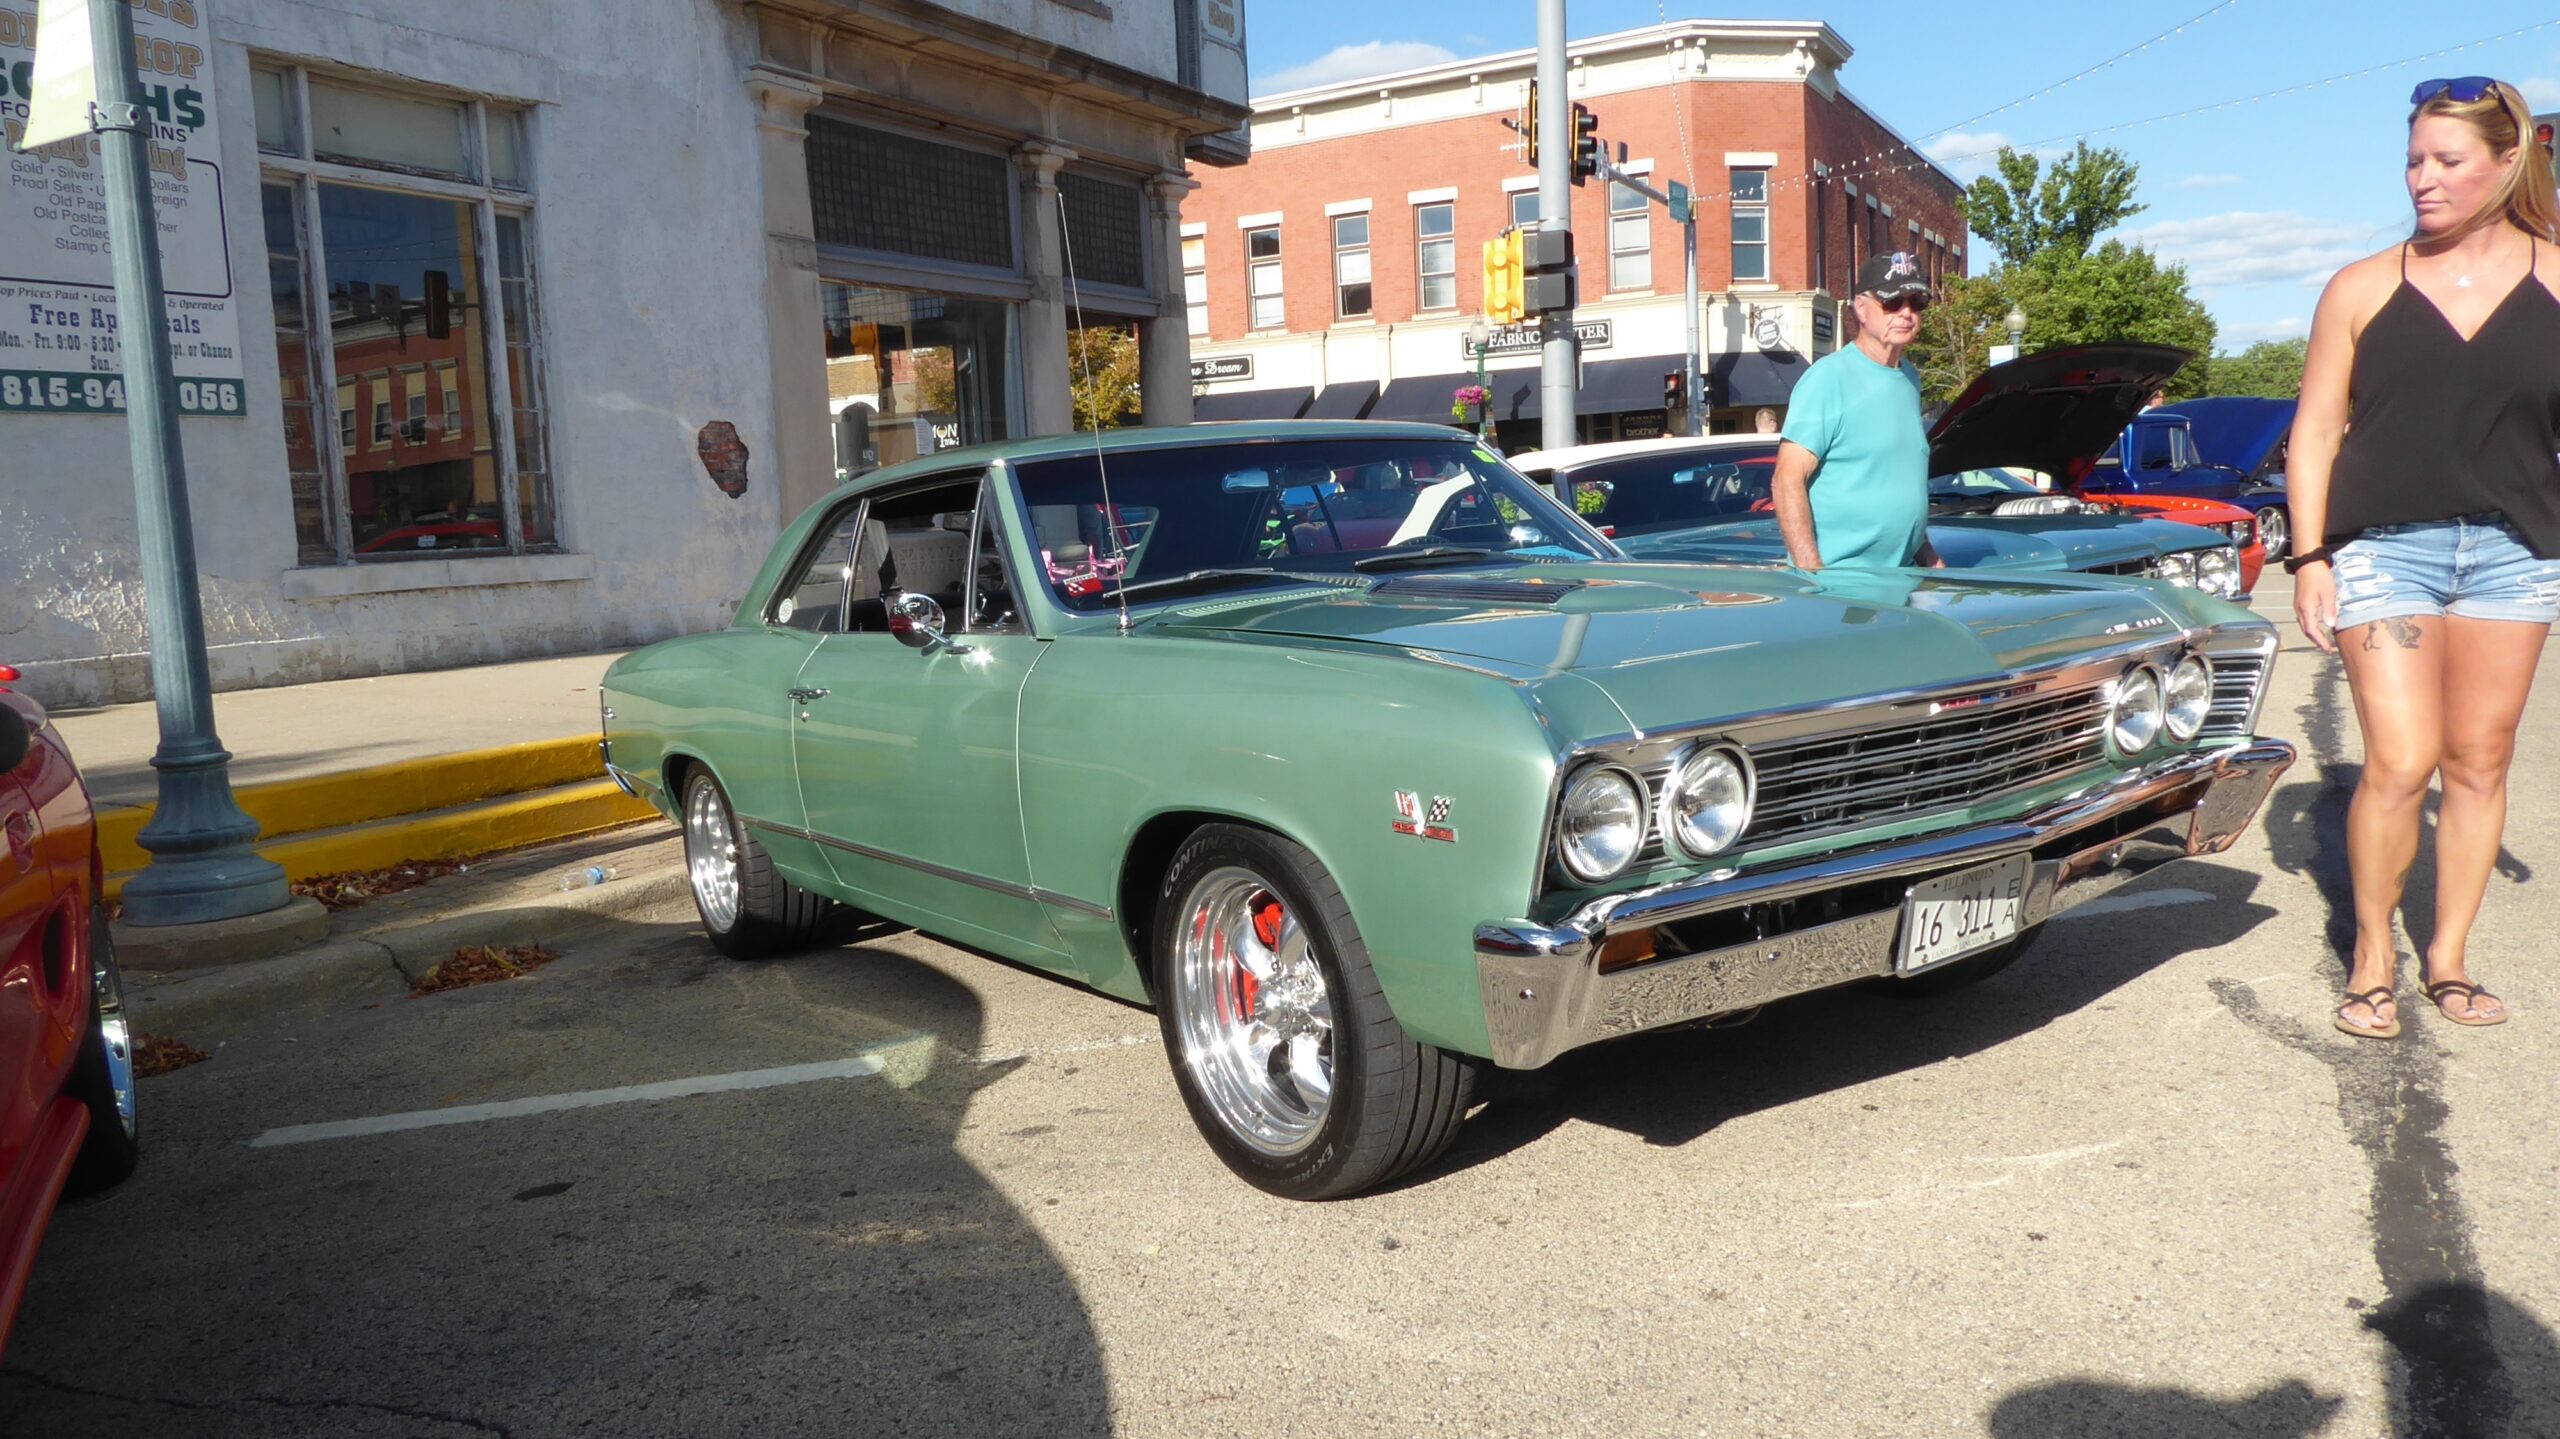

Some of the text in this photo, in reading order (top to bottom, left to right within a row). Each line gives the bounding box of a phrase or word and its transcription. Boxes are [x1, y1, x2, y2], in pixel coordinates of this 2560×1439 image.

[11, 160, 44, 175] Gold
[57, 166, 94, 181] Silver
[12, 174, 48, 190] Proof
[53, 180, 83, 194] Sets
[152, 195, 188, 208] oreign
[49, 194, 73, 207] Old
[34, 206, 58, 220] Old
[62, 209, 106, 225] Postca
[55, 237, 98, 255] Stamp
[0, 287, 15, 297] op
[18, 287, 52, 299] Prices
[55, 290, 80, 300] Paid
[179, 300, 225, 311] Operated
[29, 303, 80, 327] Free
[34, 332, 54, 349] Fri.
[57, 334, 80, 351] 9:00
[188, 345, 198, 357] or
[200, 342, 233, 359] Chance
[1488, 331, 1541, 348] FABRIC
[1573, 324, 1608, 340] TER
[90, 355, 113, 372] Sun.
[1205, 361, 1244, 375] Dream
[1943, 867, 1995, 892] ILLINOIS
[1915, 902, 1945, 953] 16
[1957, 886, 1996, 938] 311
